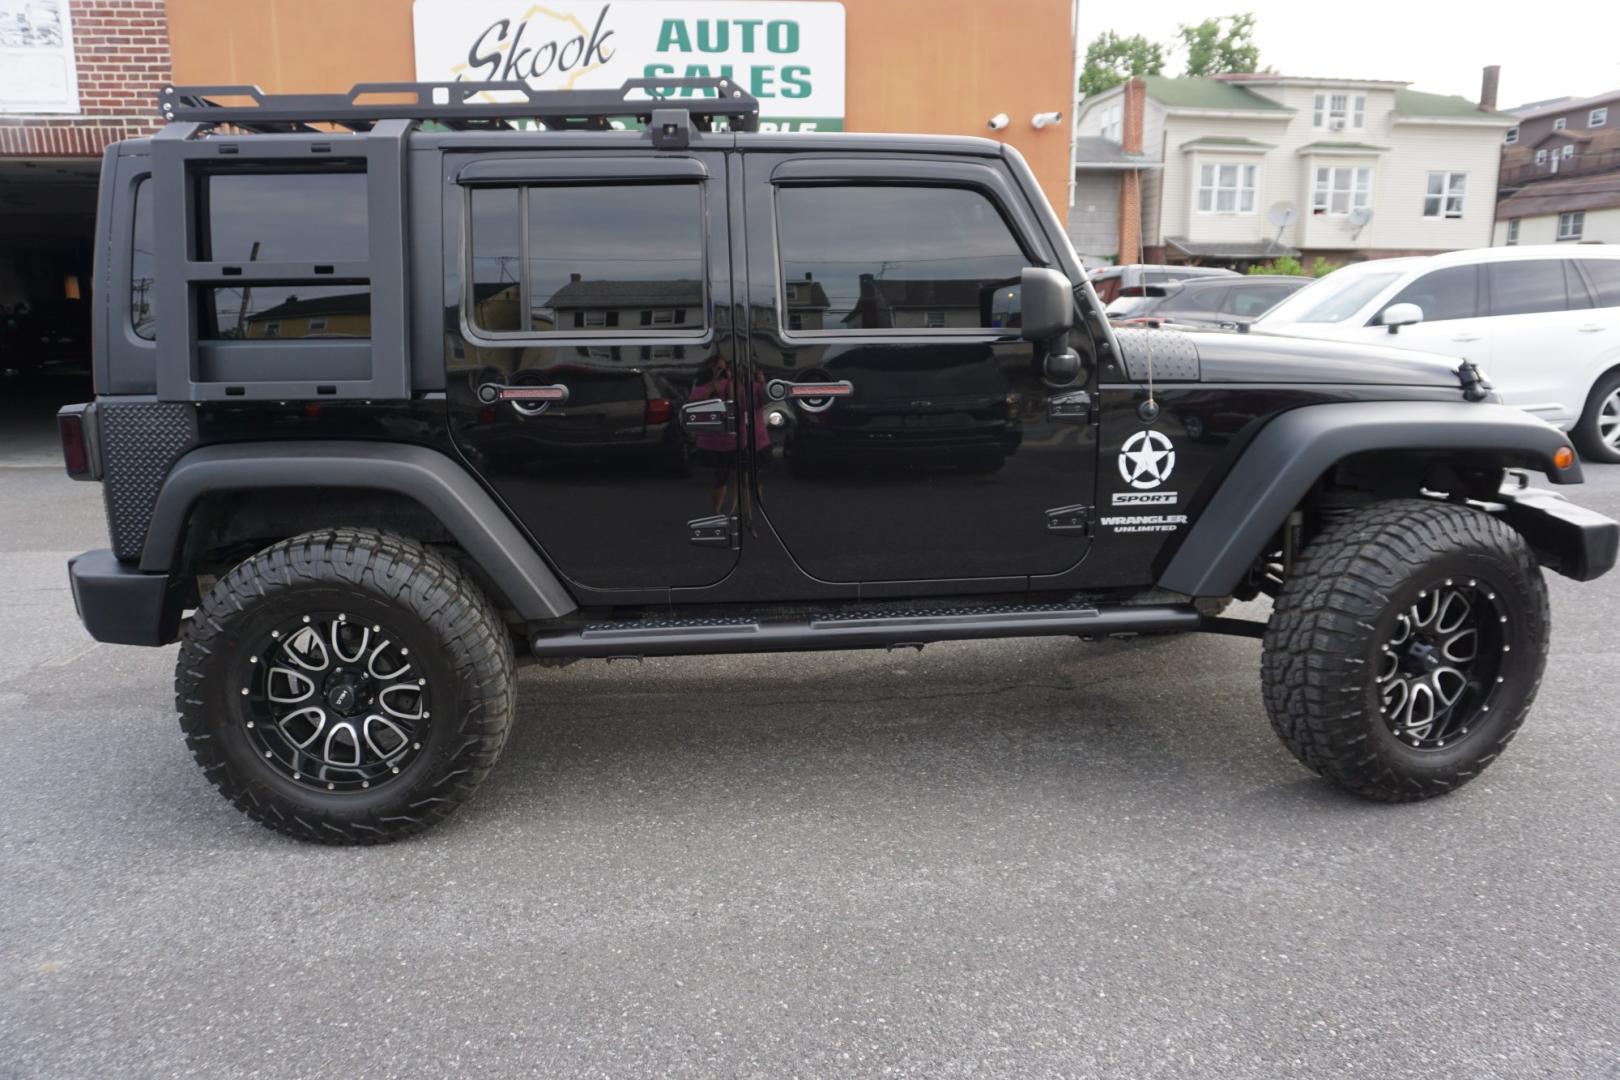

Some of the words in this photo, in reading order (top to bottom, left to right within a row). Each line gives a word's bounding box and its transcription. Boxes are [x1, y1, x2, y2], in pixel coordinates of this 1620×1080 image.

[656, 19, 800, 53] AUTO
[457, 4, 616, 82] Skook
[1115, 494, 1173, 503] SPORT
[1100, 515, 1188, 525] WRANGLER
[1114, 525, 1177, 533] UNLIMITED
